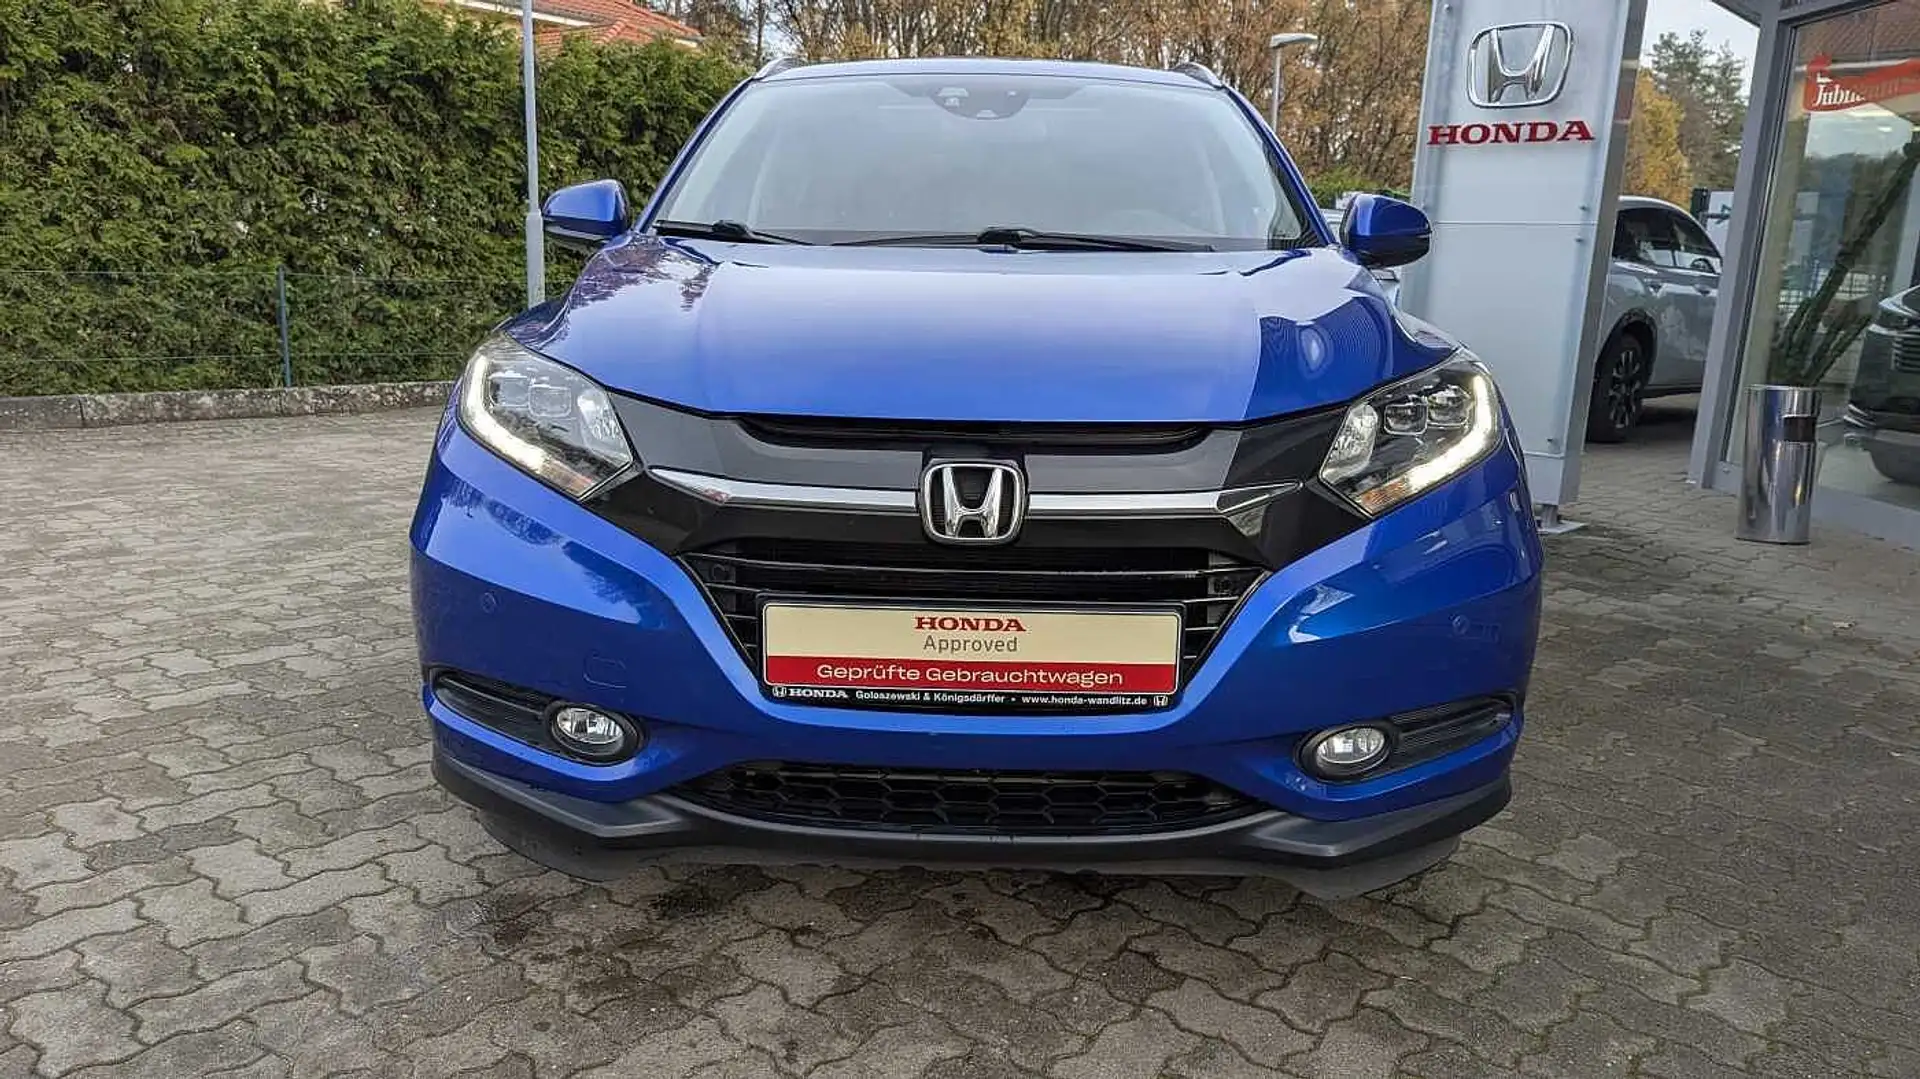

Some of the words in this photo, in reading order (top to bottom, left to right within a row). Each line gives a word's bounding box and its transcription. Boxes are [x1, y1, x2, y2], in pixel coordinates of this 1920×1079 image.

[1427, 120, 1596, 145] HONDA
[914, 617, 1026, 631] HONDA
[923, 635, 1018, 654] Approved
[817, 664, 920, 682] Geprüfte
[926, 667, 1123, 688] Gebrauchtwagen
[788, 688, 849, 699] HONDA
[923, 693, 931, 701] &
[1021, 696, 1148, 706] www.honda-wandlitz.de
